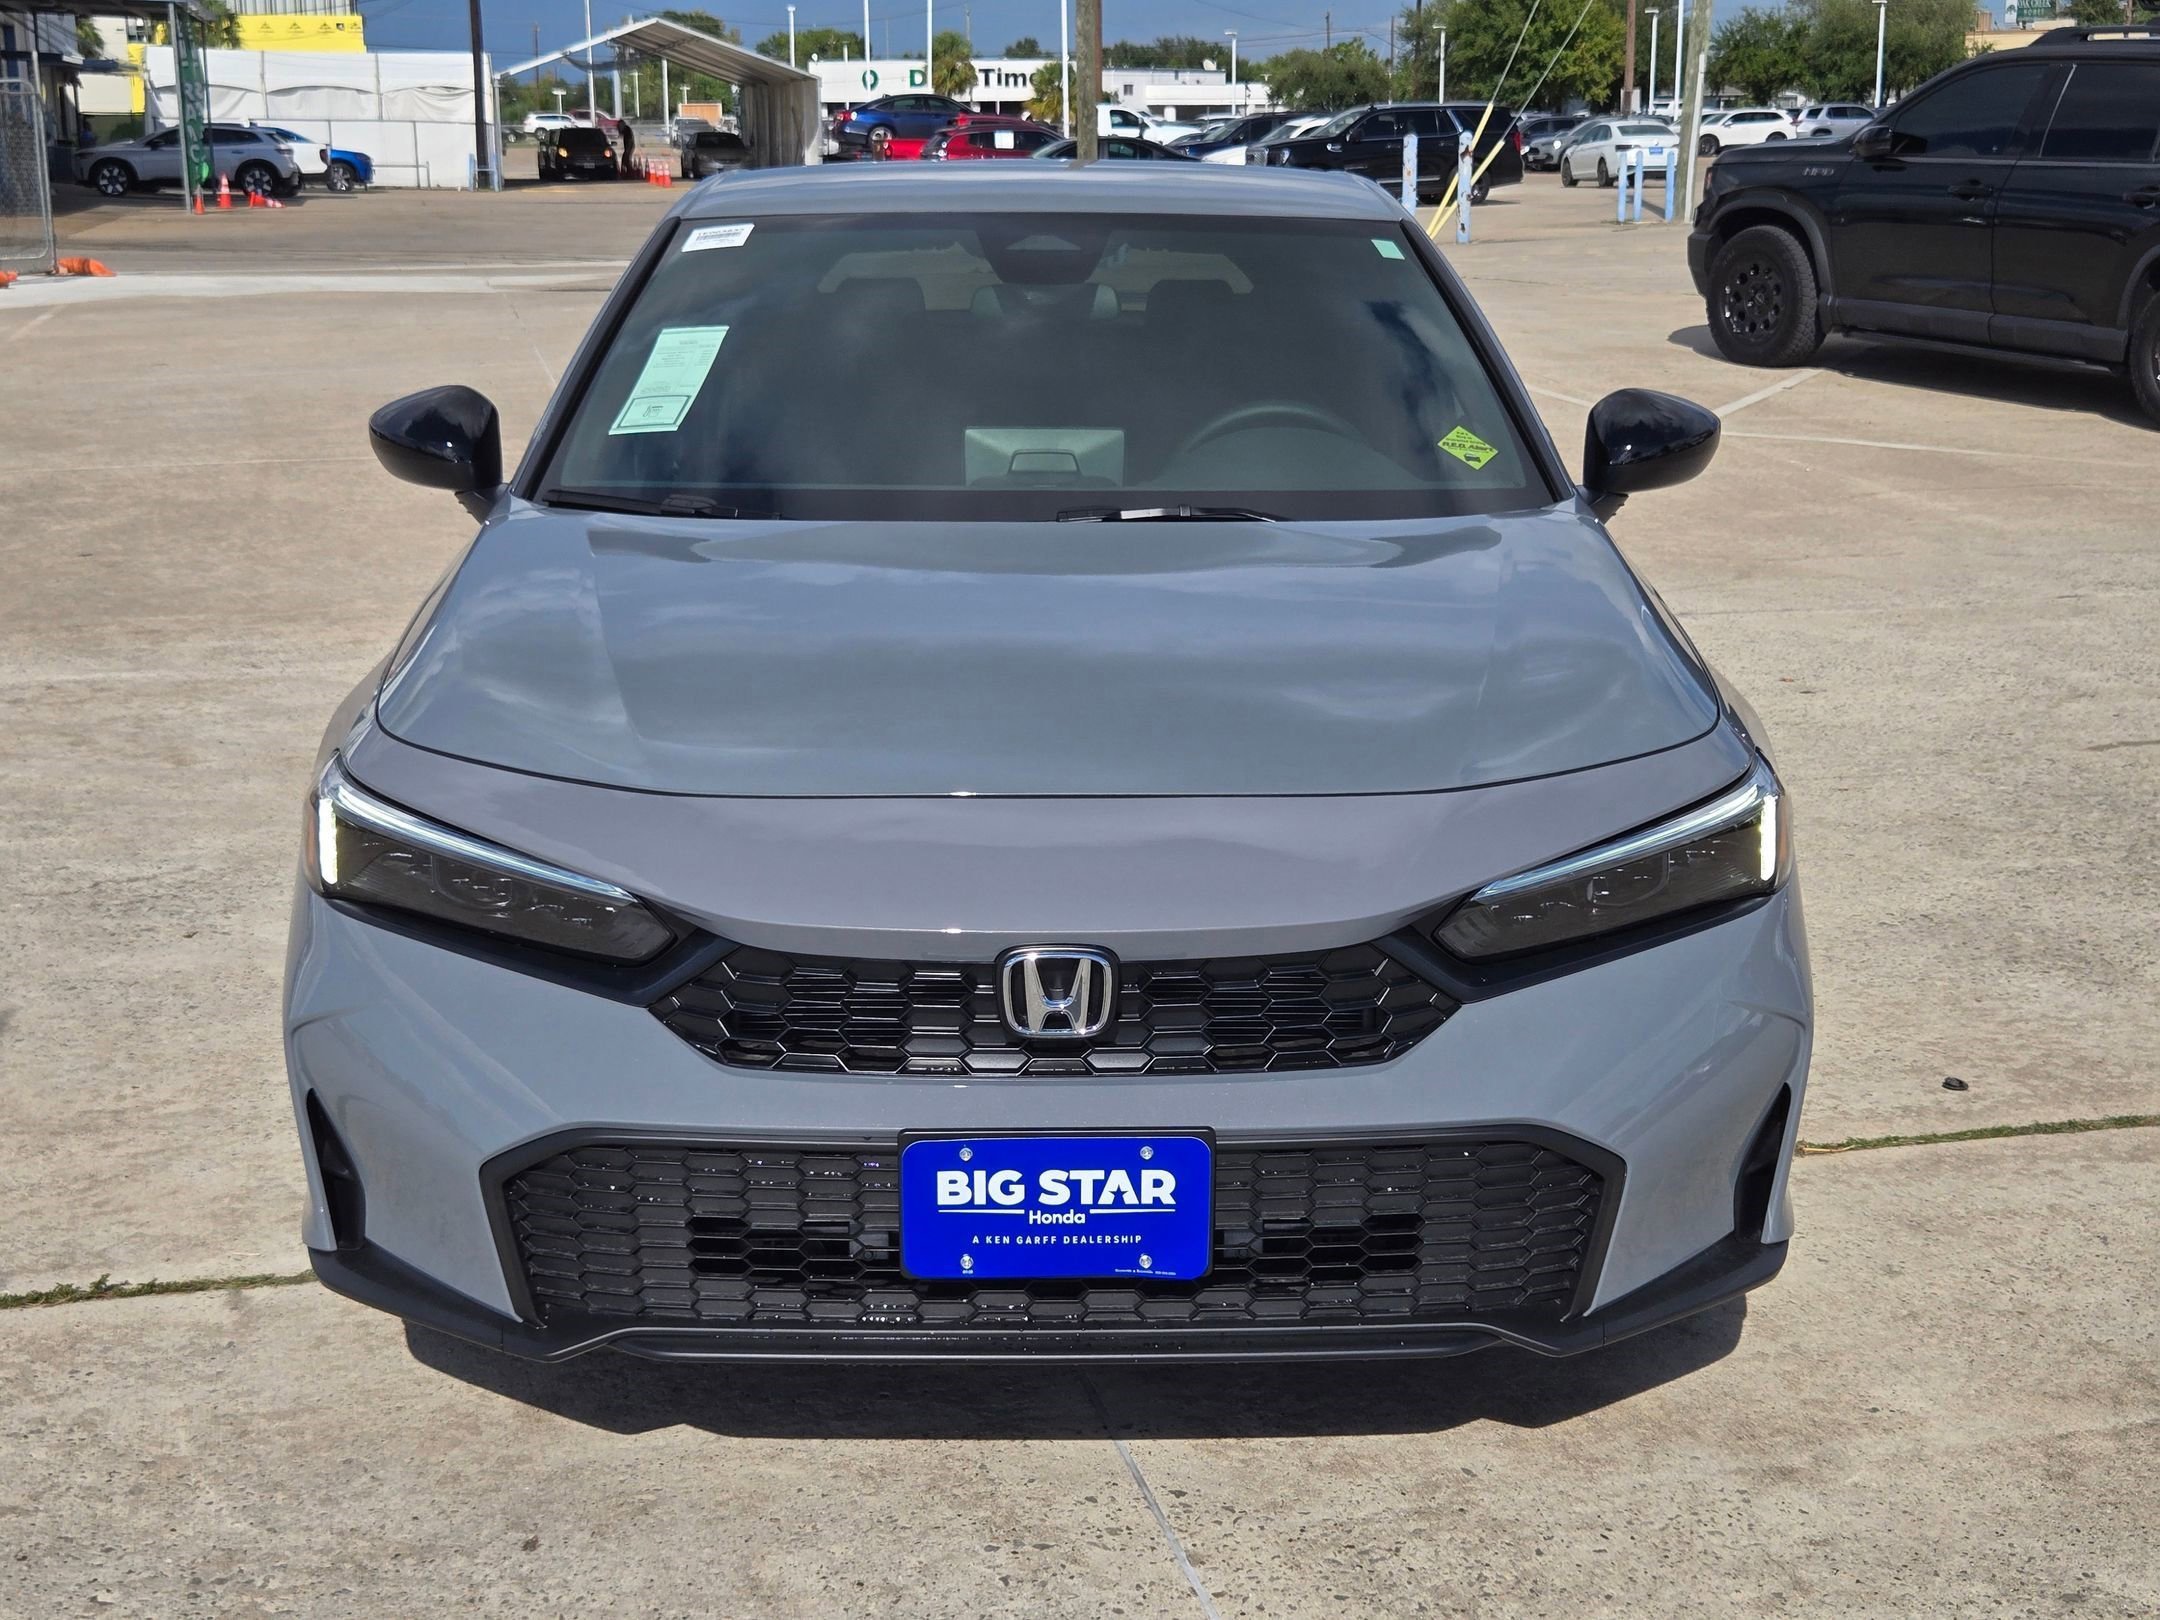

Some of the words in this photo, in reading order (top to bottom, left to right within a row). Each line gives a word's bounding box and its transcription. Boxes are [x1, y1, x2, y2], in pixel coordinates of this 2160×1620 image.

[936, 1169, 1026, 1206] BIG
[1038, 1169, 1177, 1205] STAR
[1028, 1209, 1086, 1225] Honda
[972, 1235, 980, 1245] A
[986, 1235, 1010, 1245] KEN
[1016, 1235, 1058, 1245] GARFF
[1063, 1235, 1143, 1245] DEALERSHIP
